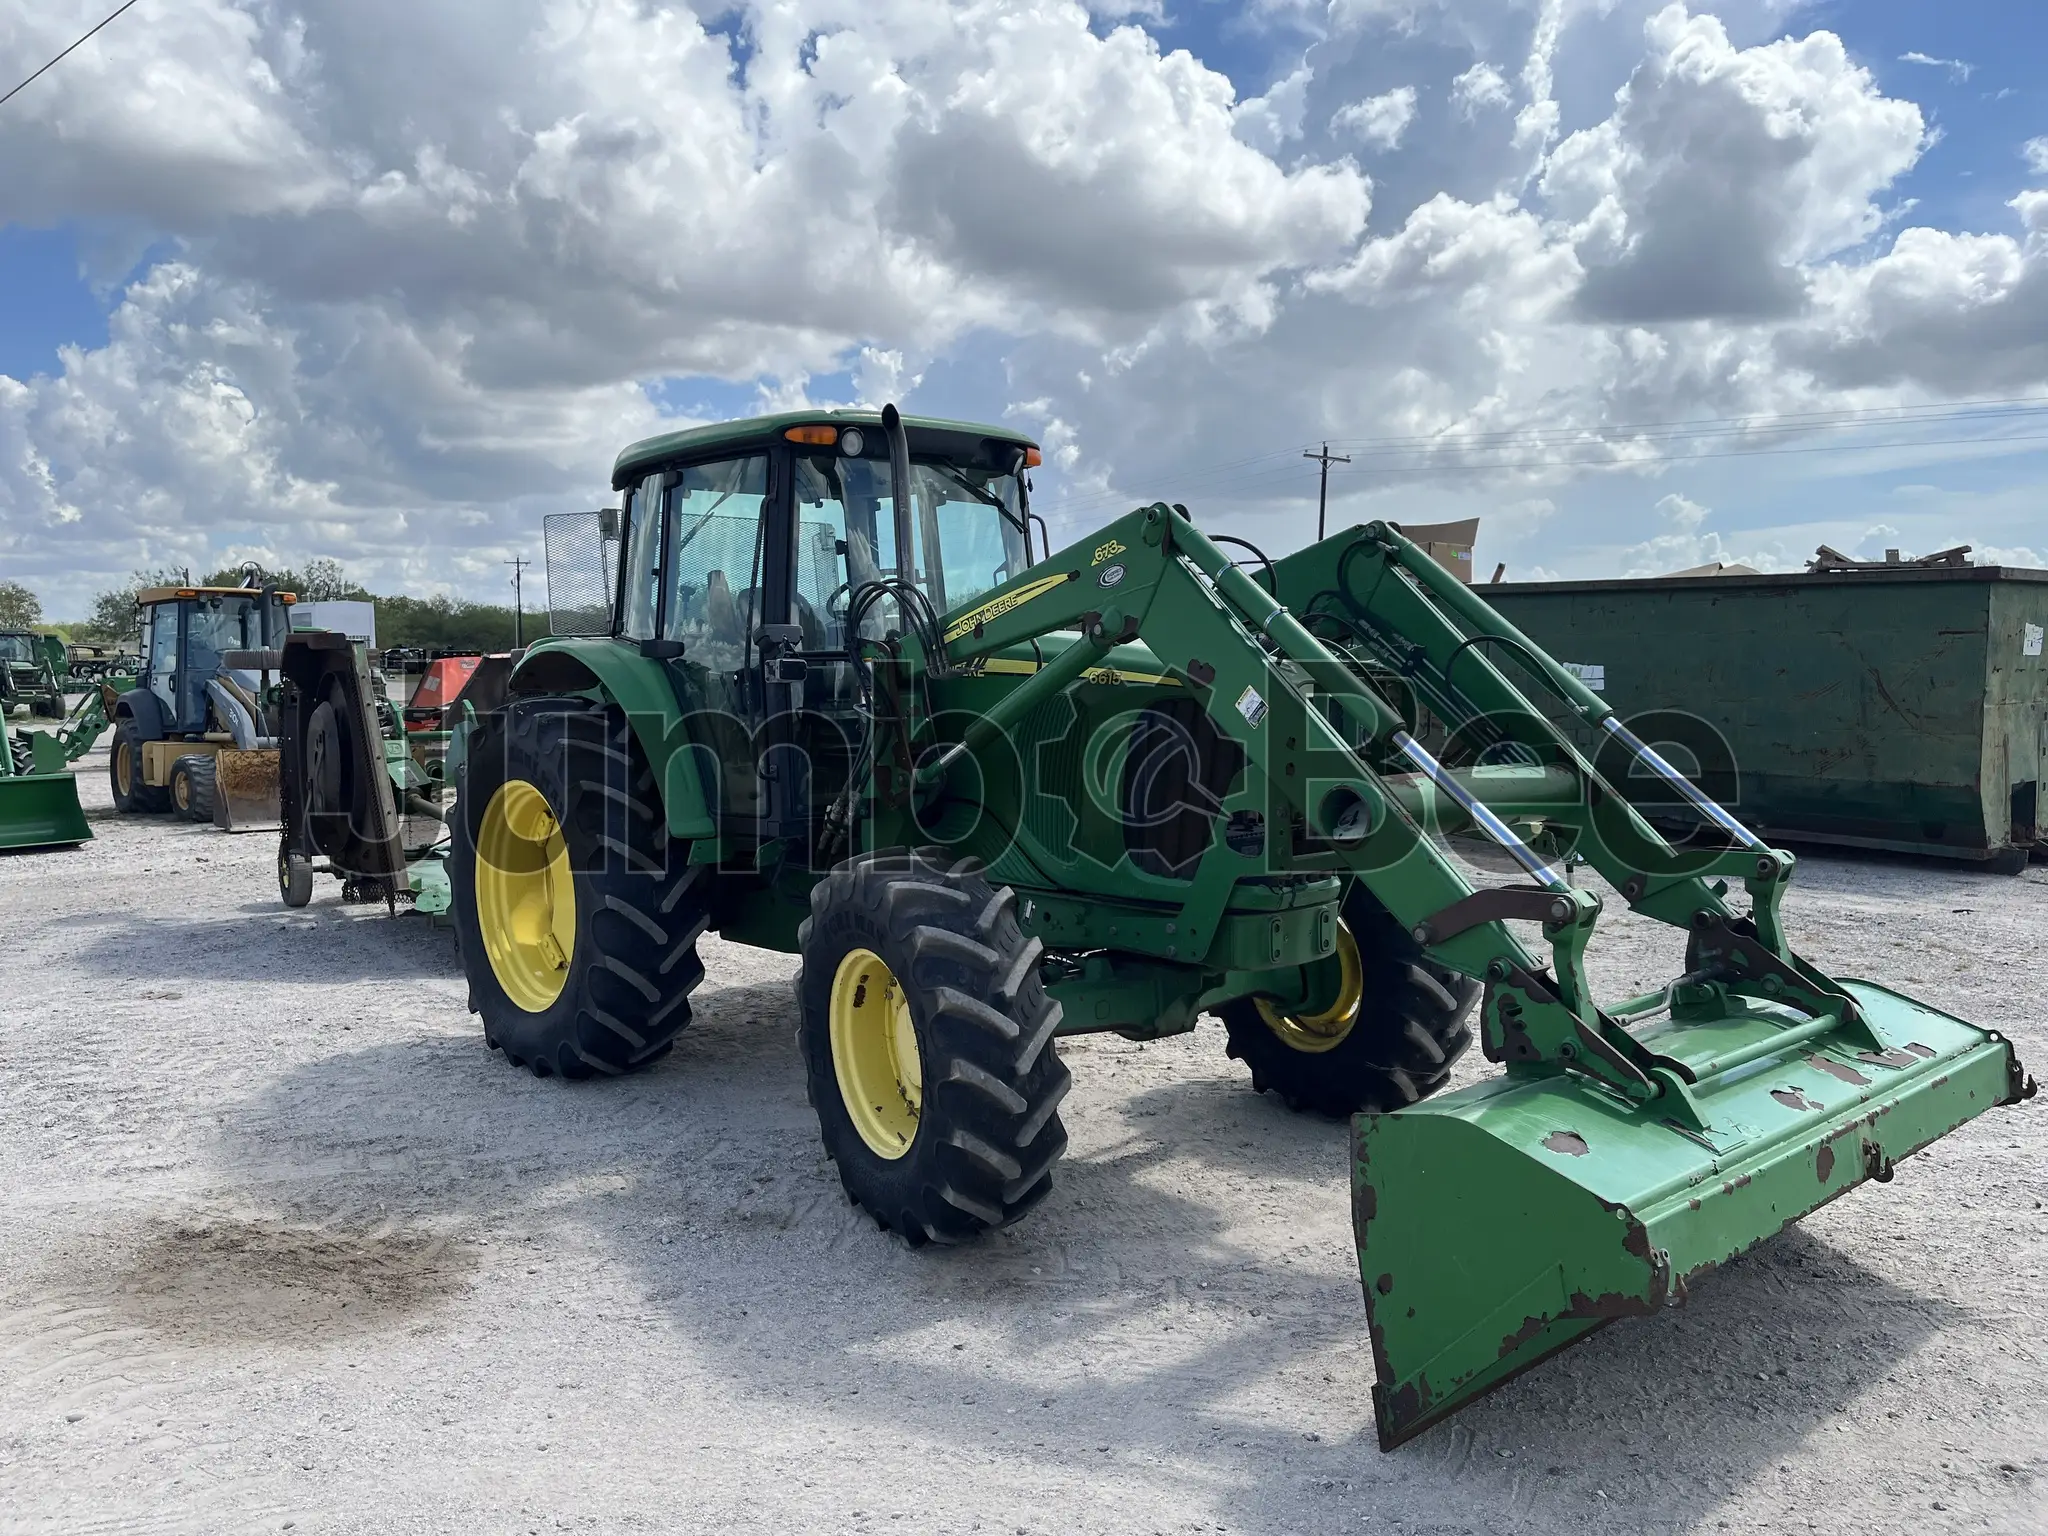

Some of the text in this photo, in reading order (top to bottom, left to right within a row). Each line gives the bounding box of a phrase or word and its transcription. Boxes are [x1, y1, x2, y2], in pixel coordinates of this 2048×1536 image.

[1094, 539, 1118, 561] 673
[956, 594, 1018, 636] JOHN DEERE
[1089, 670, 1122, 685] 6615
